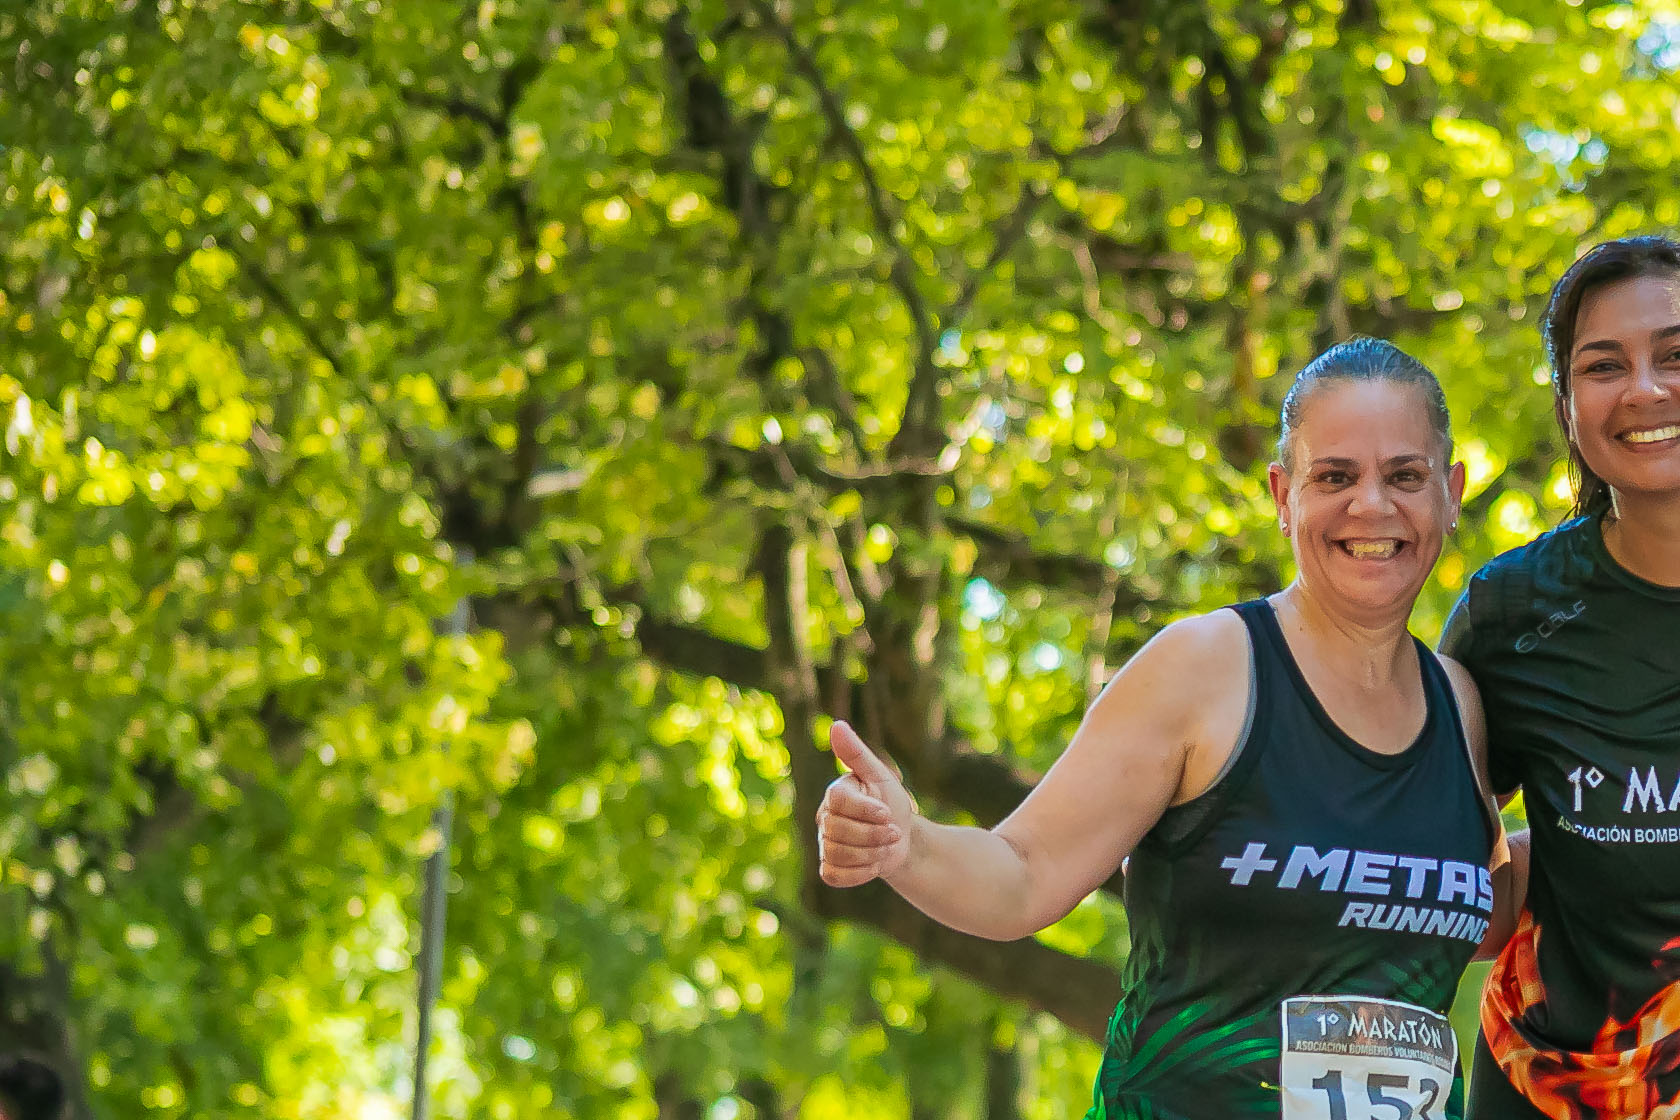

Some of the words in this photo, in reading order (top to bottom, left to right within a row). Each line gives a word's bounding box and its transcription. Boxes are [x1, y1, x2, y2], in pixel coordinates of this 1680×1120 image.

[1220, 842, 1494, 913] +METAS
[1338, 901, 1490, 945] RUNNING
[1347, 1012, 1443, 1049] MARATÓN
